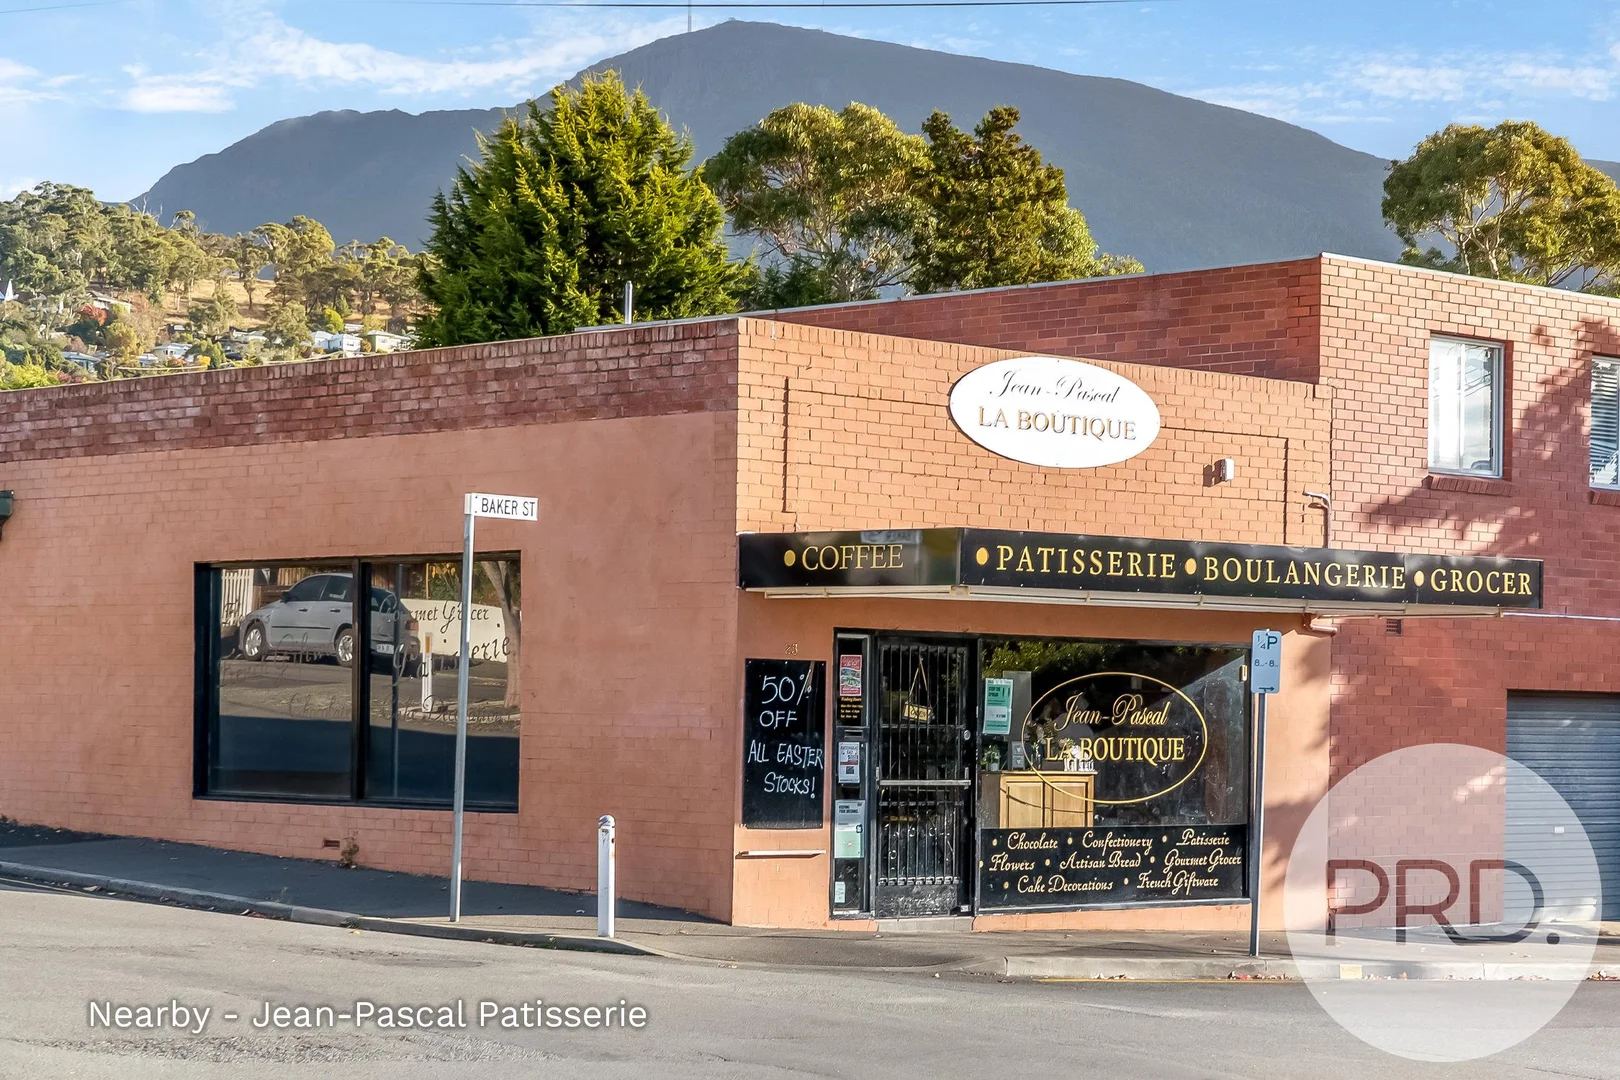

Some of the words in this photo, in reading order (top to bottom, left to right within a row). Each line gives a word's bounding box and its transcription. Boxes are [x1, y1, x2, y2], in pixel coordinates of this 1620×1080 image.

[978, 405, 1009, 429] LA
[1017, 409, 1137, 442] BOUTIQUE
[481, 497, 518, 515] BAKER
[522, 500, 536, 517] ST
[801, 543, 904, 571] COFFEE
[996, 544, 1176, 579] PATISSERIE
[1203, 556, 1406, 590] BOULANGERIE
[1430, 567, 1533, 596] GROCER
[761, 669, 812, 706] 50%
[759, 710, 798, 729] OFF
[1053, 691, 1172, 731] Jean-Pascal
[747, 739, 770, 764] ALL
[776, 743, 824, 770] EASTER
[1045, 737, 1075, 762] LA
[1079, 737, 1186, 767] BOUTIQUE
[763, 771, 816, 799] STOCKS!
[1007, 831, 1058, 850] Chocolate
[1082, 830, 1153, 857] Confectionery
[1175, 828, 1230, 846] Patisserie
[988, 851, 1036, 872] Flowers
[1059, 851, 1107, 870] Artisan
[1107, 852, 1141, 869] Bread
[1164, 847, 1209, 874] Gourmet
[1207, 848, 1242, 873] Grocer
[1017, 874, 1046, 894] Cake
[1047, 874, 1114, 893] Decorations
[1136, 870, 1172, 889] French
[1171, 869, 1220, 896] Giftware
